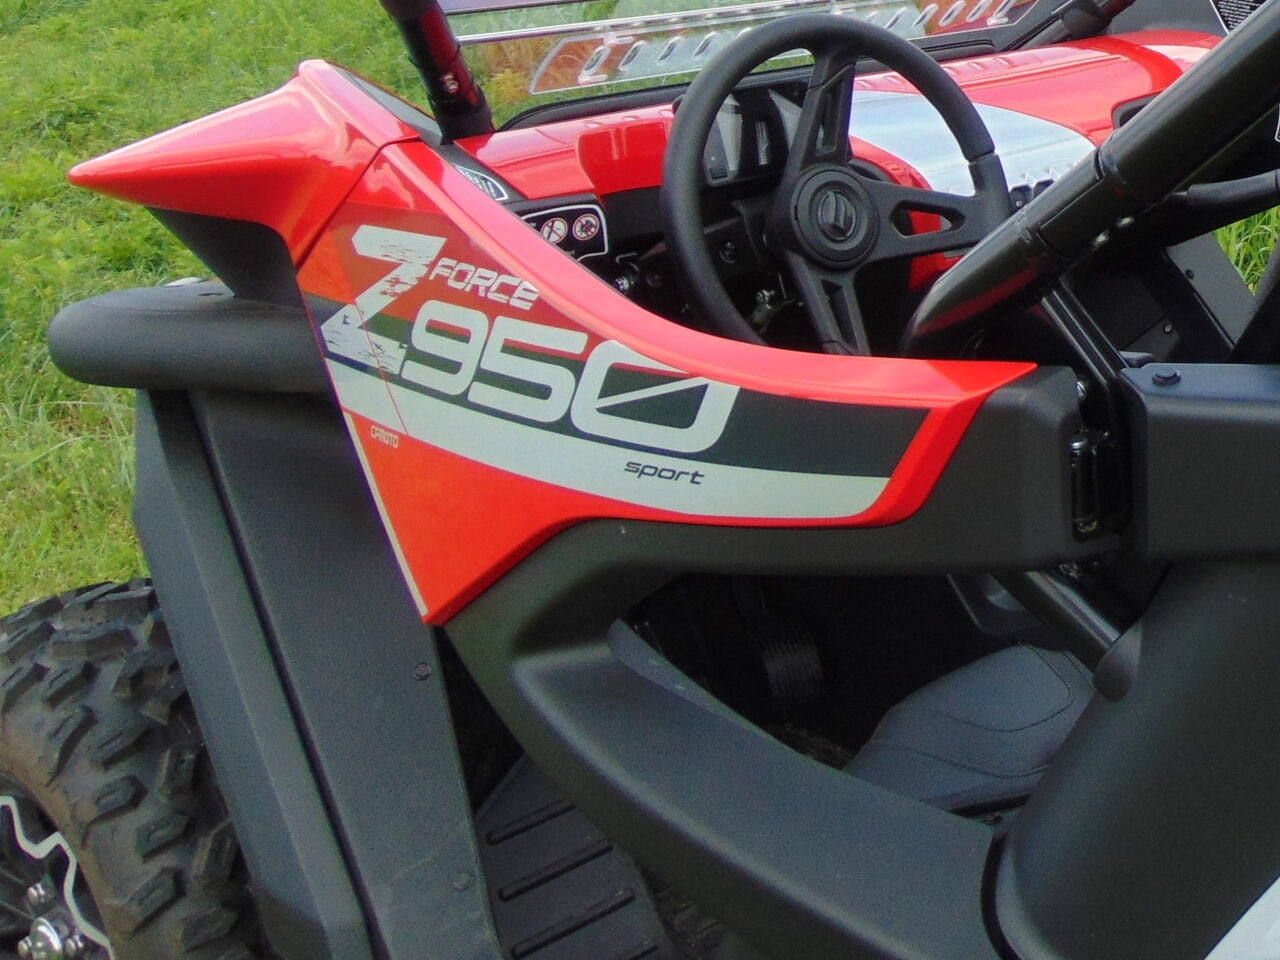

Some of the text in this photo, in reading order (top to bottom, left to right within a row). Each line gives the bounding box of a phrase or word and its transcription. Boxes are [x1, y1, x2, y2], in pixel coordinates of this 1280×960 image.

[429, 257, 540, 310] FORCE
[401, 300, 740, 453] 950
[624, 461, 705, 485] sport
